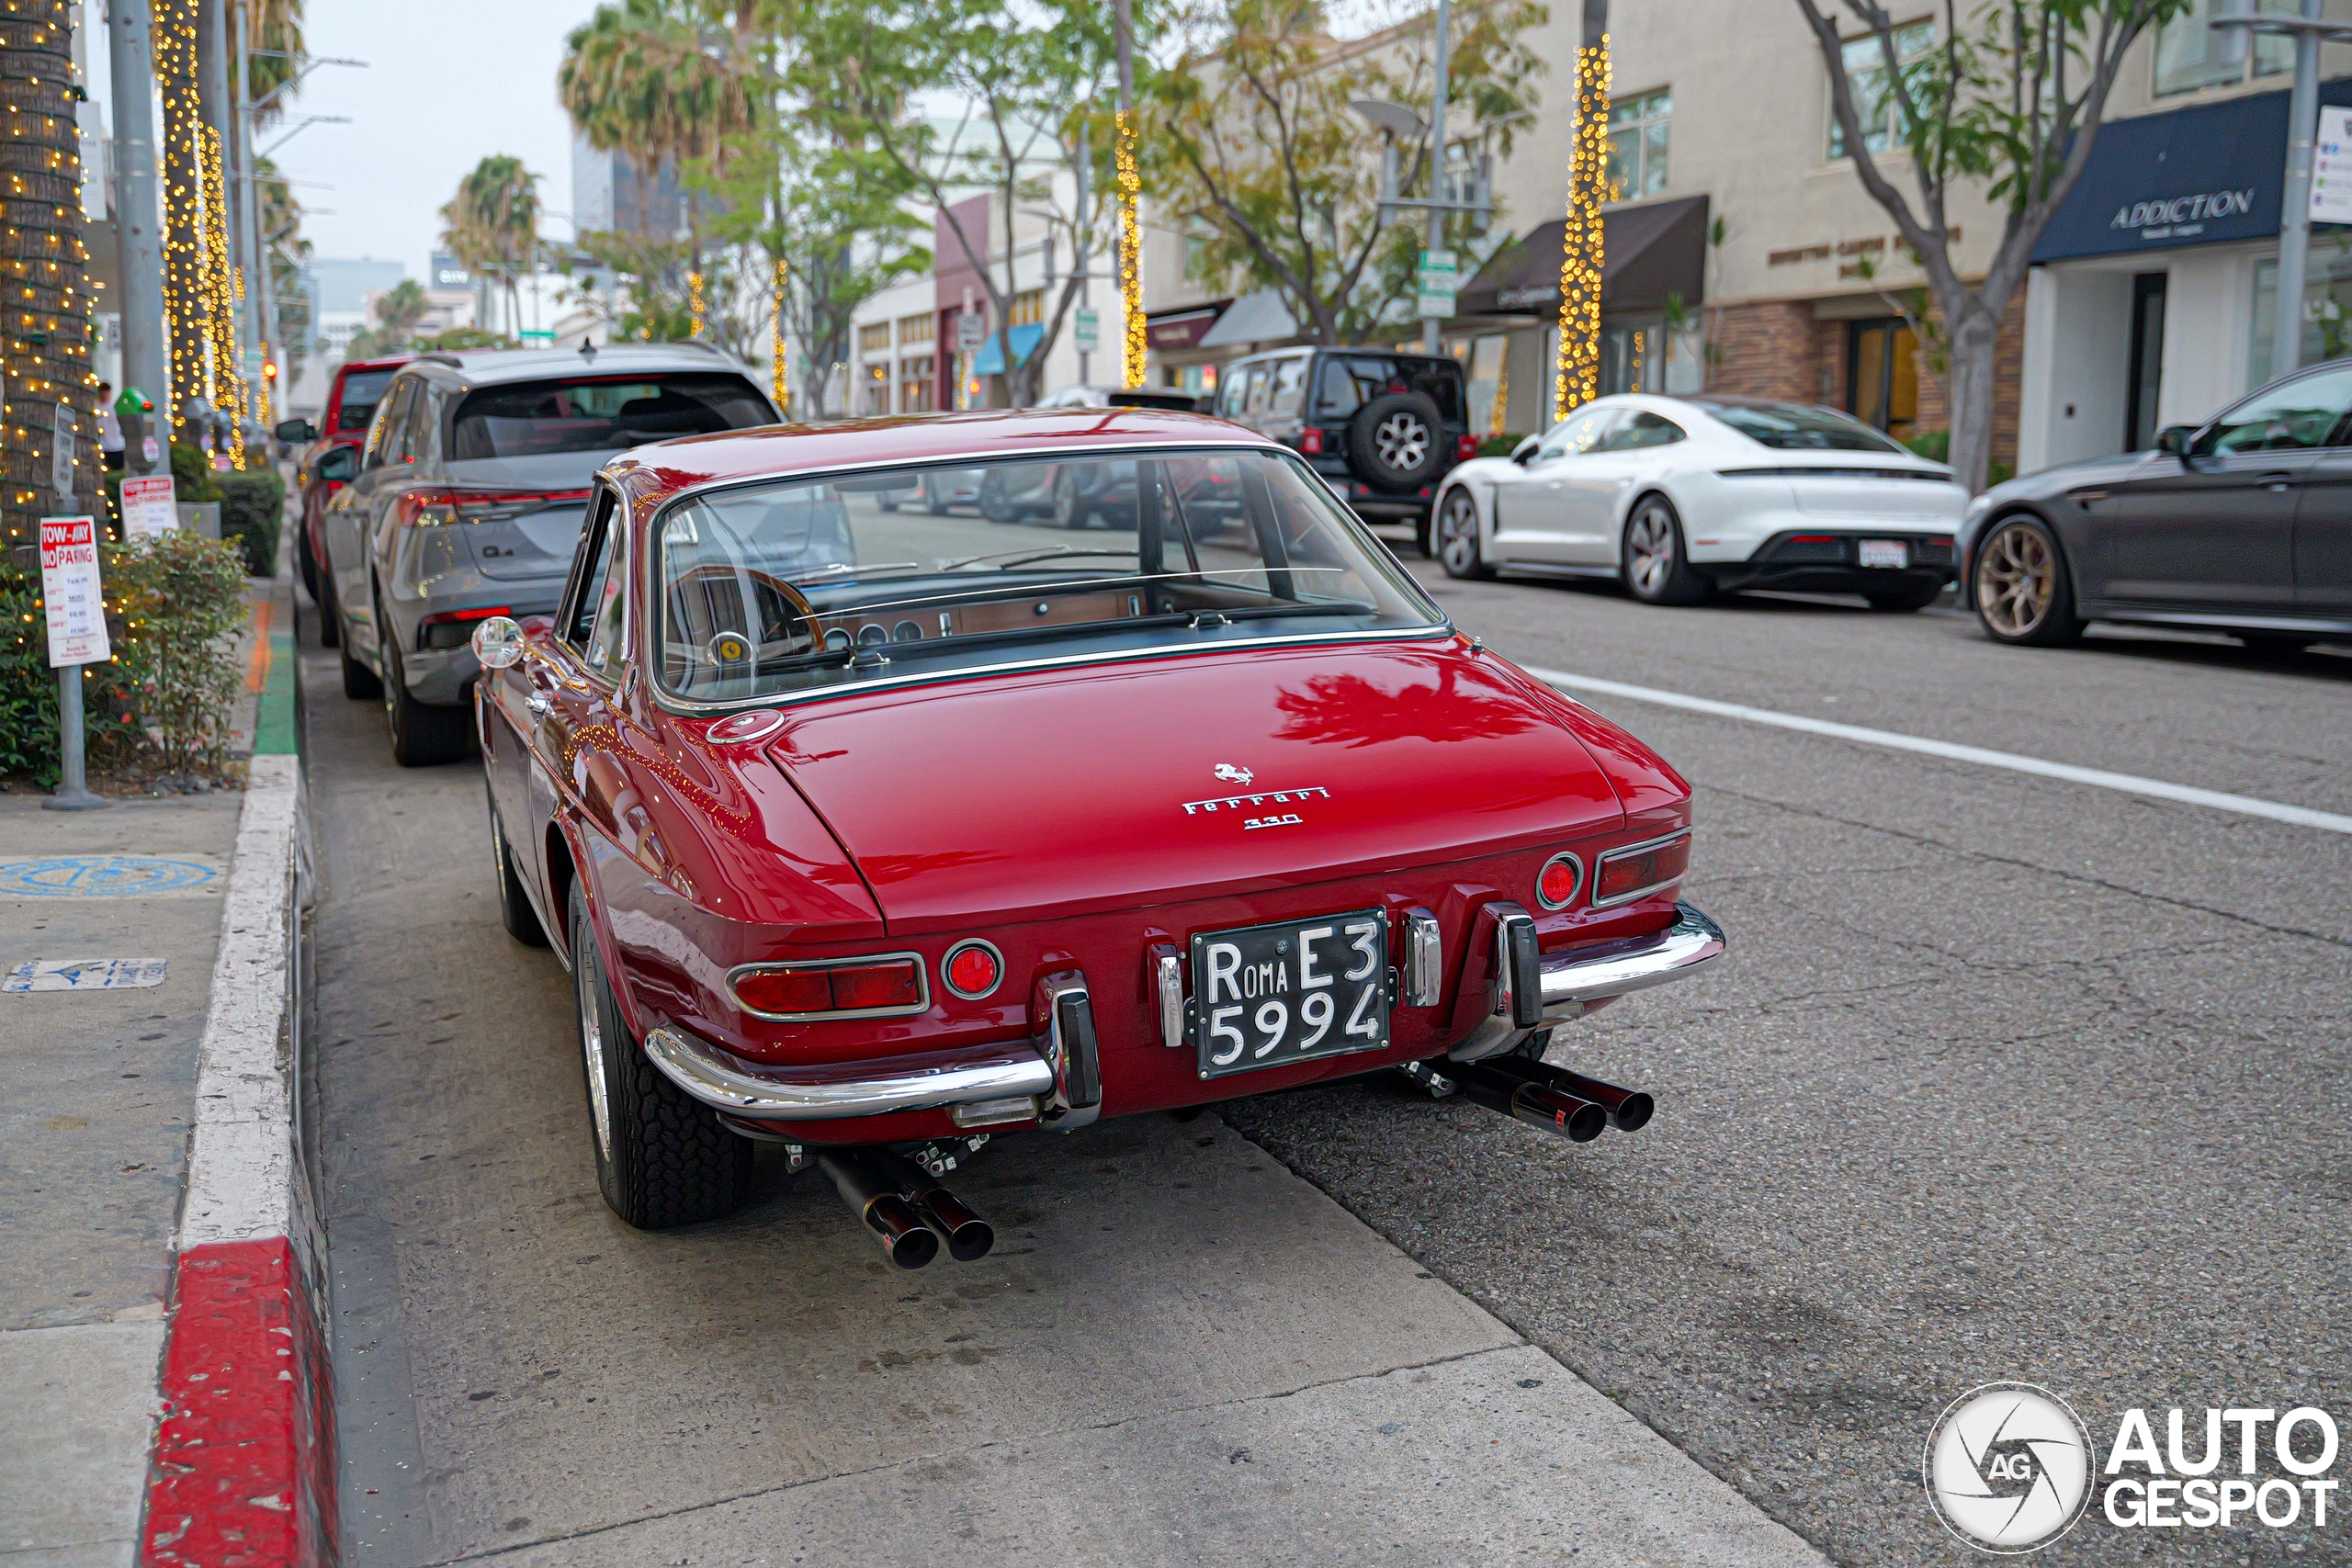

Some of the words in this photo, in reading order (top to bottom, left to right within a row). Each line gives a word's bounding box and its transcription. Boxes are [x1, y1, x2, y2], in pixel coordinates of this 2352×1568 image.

[2109, 187, 2255, 230] ADDICTION
[43, 549, 56, 568] NO
[1182, 786, 1330, 815] Ferrari
[1244, 814, 1303, 830] 330
[1211, 983, 1379, 1066] 5994
